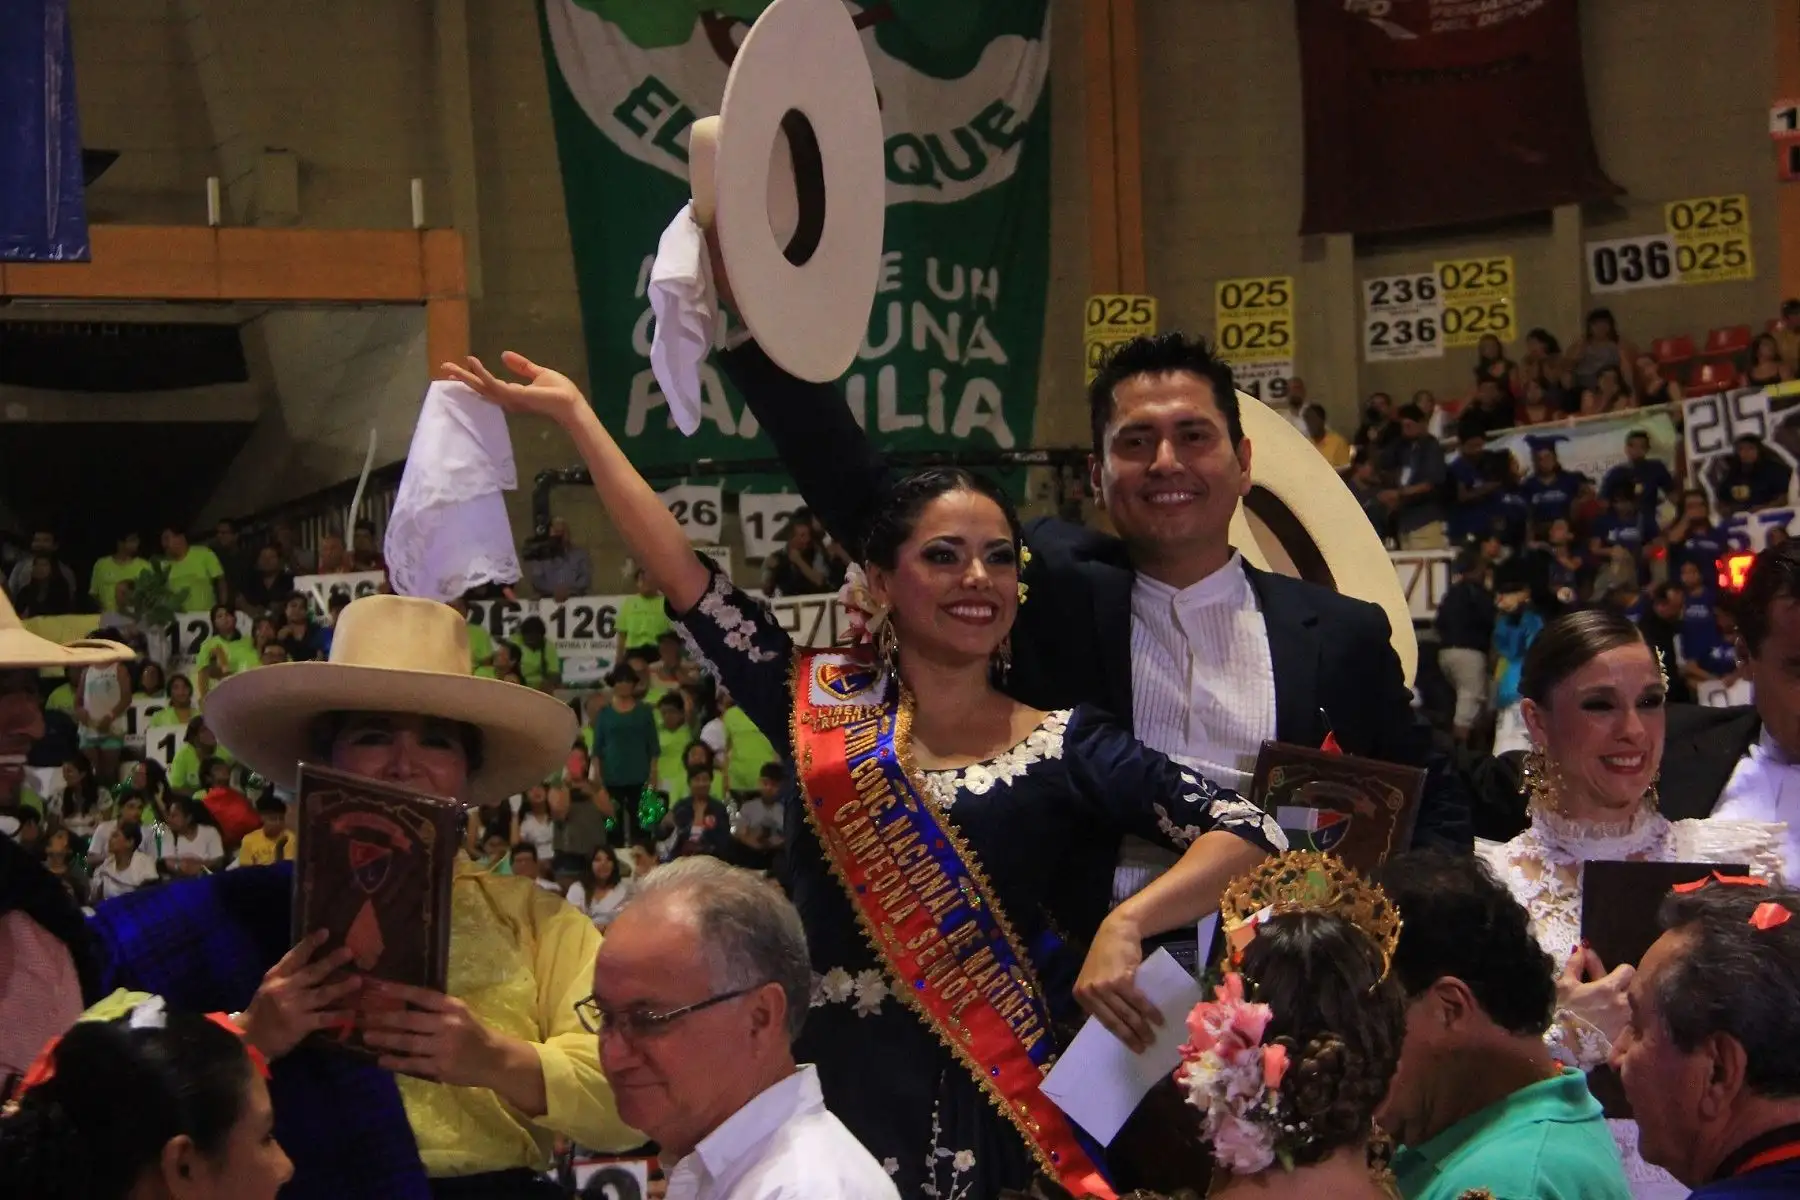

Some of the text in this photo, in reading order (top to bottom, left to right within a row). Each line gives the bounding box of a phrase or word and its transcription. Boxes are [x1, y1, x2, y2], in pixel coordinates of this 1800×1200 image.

[613, 74, 692, 164] EL
[1671, 198, 1742, 231] 025
[1594, 240, 1670, 285] 036
[1676, 240, 1746, 272] 025
[1369, 276, 1436, 306] 236
[1440, 260, 1508, 291] 025
[1087, 298, 1151, 326] 025
[1220, 280, 1288, 310] 025
[1221, 321, 1289, 350] 025
[1369, 318, 1436, 346] 236
[1441, 303, 1510, 334] 025
[1233, 377, 1289, 400] 19
[624, 364, 1016, 449] FAILIA
[165, 619, 210, 655] 12
[550, 604, 617, 639] 126
[850, 756, 896, 817] CONC
[880, 815, 966, 924] NACIONAL
[834, 799, 979, 1016] CAMPEONA SENIOR
[947, 920, 985, 955] DE
[962, 946, 1045, 1051] MARINERA
